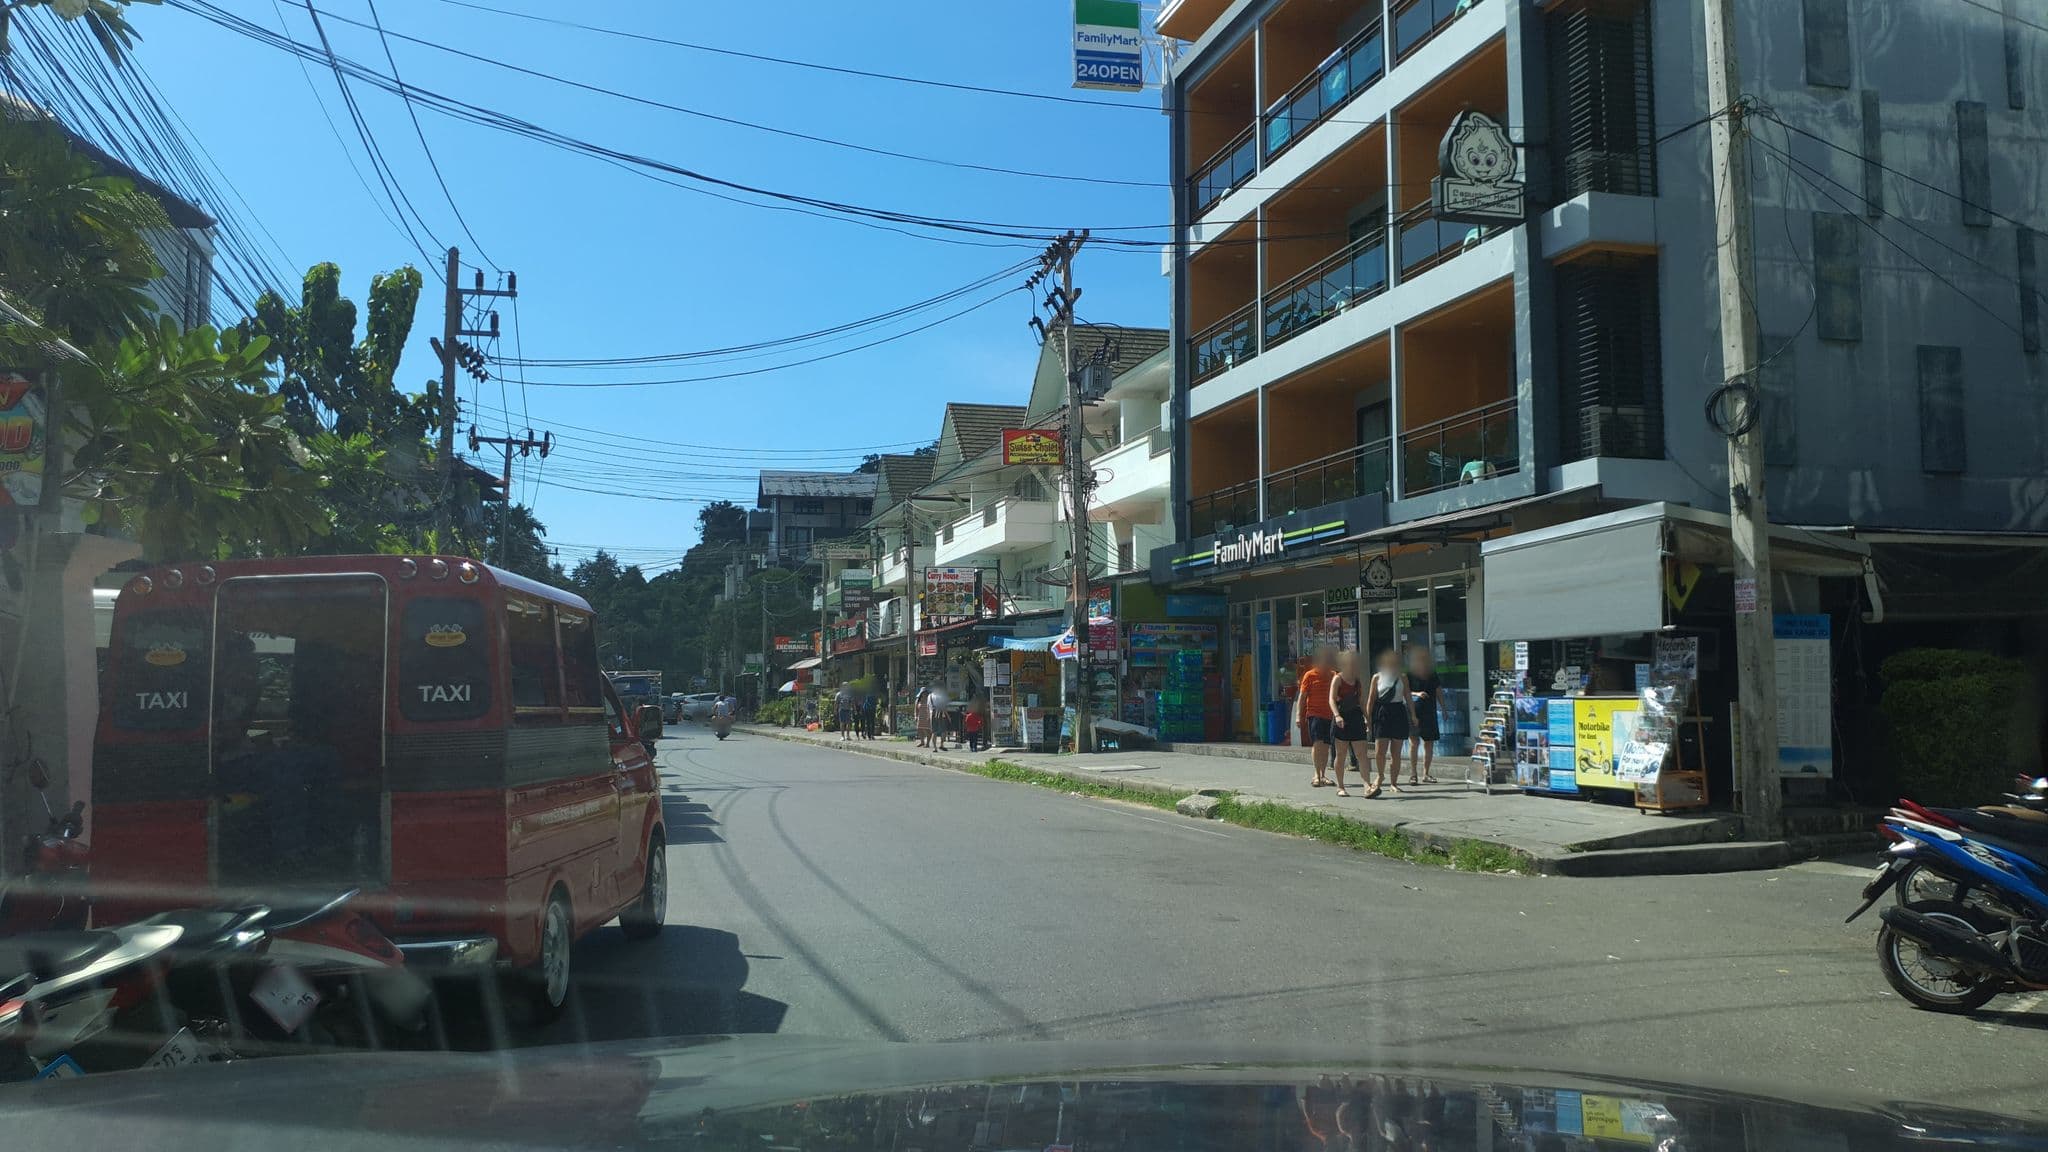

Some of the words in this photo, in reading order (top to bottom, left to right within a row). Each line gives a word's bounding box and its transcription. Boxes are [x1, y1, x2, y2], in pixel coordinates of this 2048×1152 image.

[1077, 31, 1139, 47] FamilyMart
[1213, 527, 1284, 565] FamilyMart
[928, 571, 942, 581] Curry
[943, 571, 959, 580] House
[135, 691, 188, 709] TAXI
[417, 684, 471, 702] TAXI
[1578, 722, 1610, 732] Motorbike
